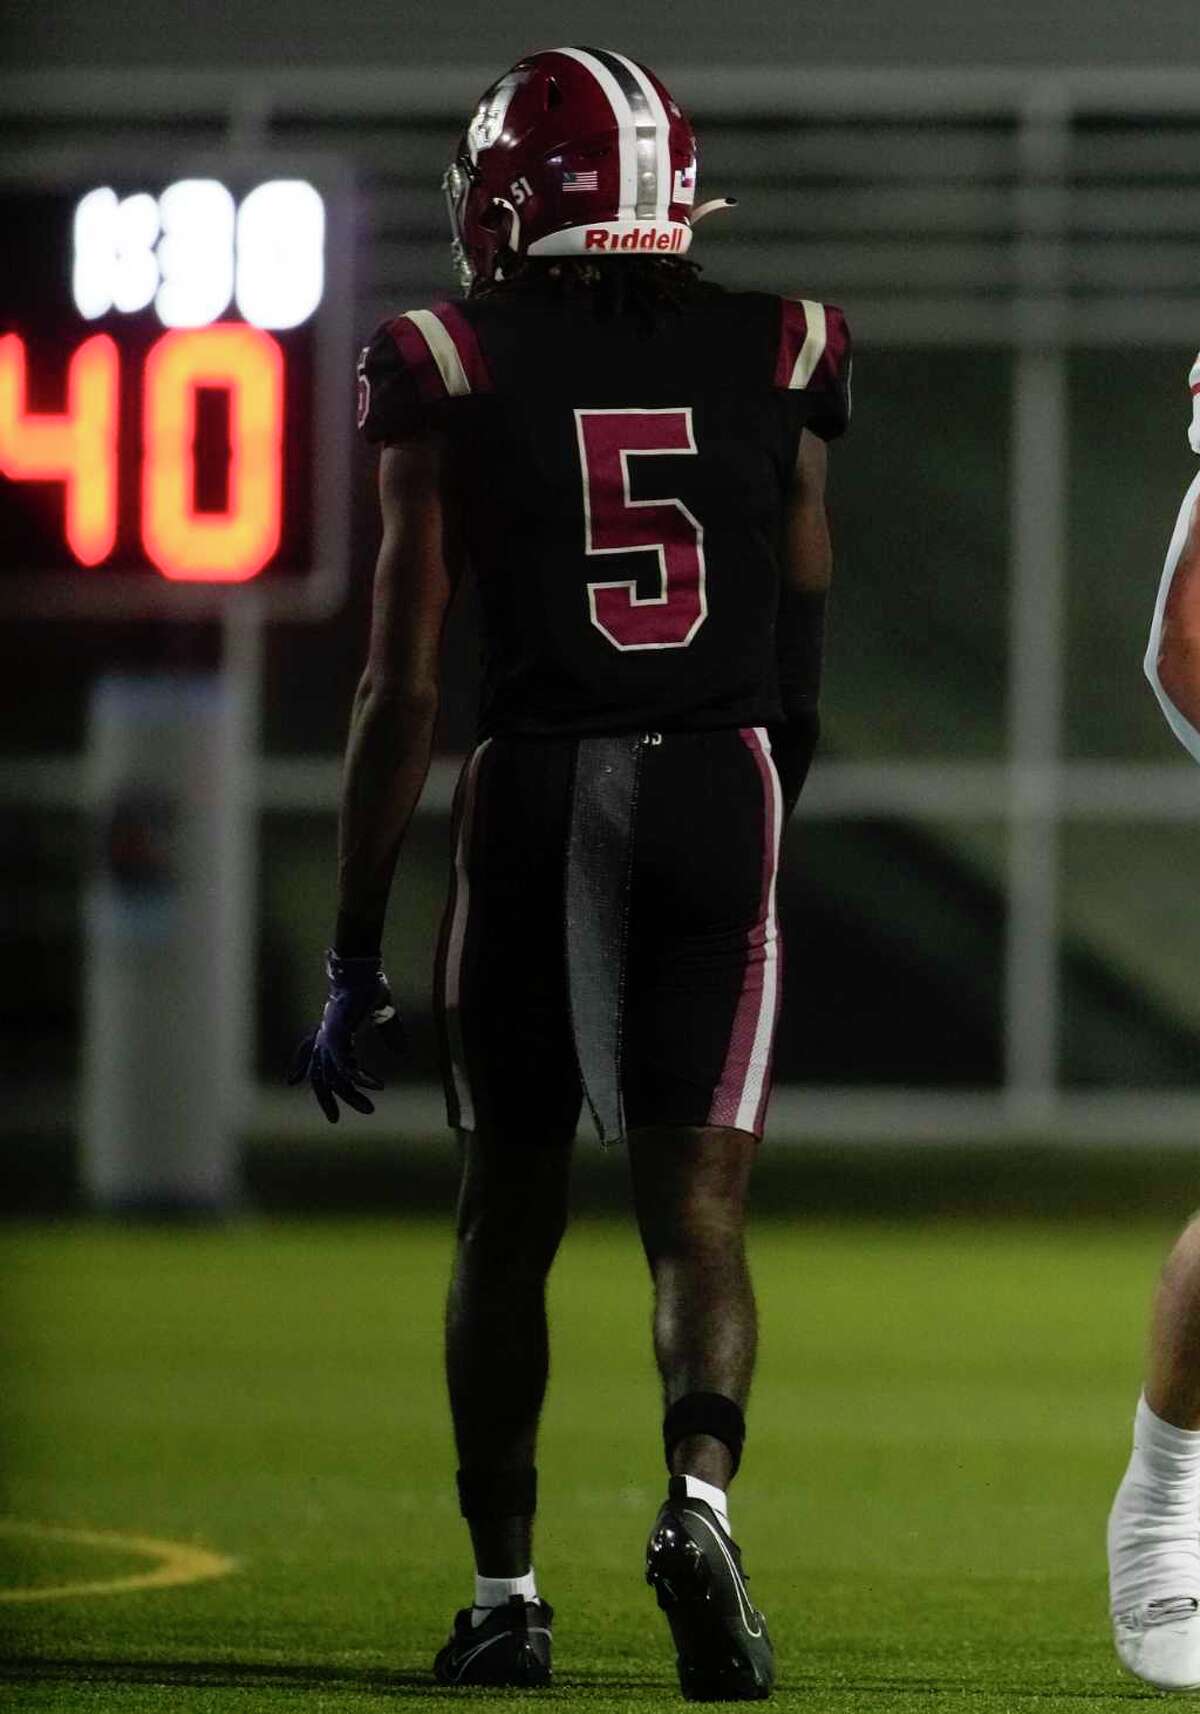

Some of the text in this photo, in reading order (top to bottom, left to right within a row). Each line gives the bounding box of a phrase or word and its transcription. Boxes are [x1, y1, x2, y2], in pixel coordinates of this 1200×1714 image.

[511, 176, 533, 205] 51
[585, 228, 683, 250] Riddell
[0, 321, 285, 582] 40
[573, 407, 708, 651] 5
